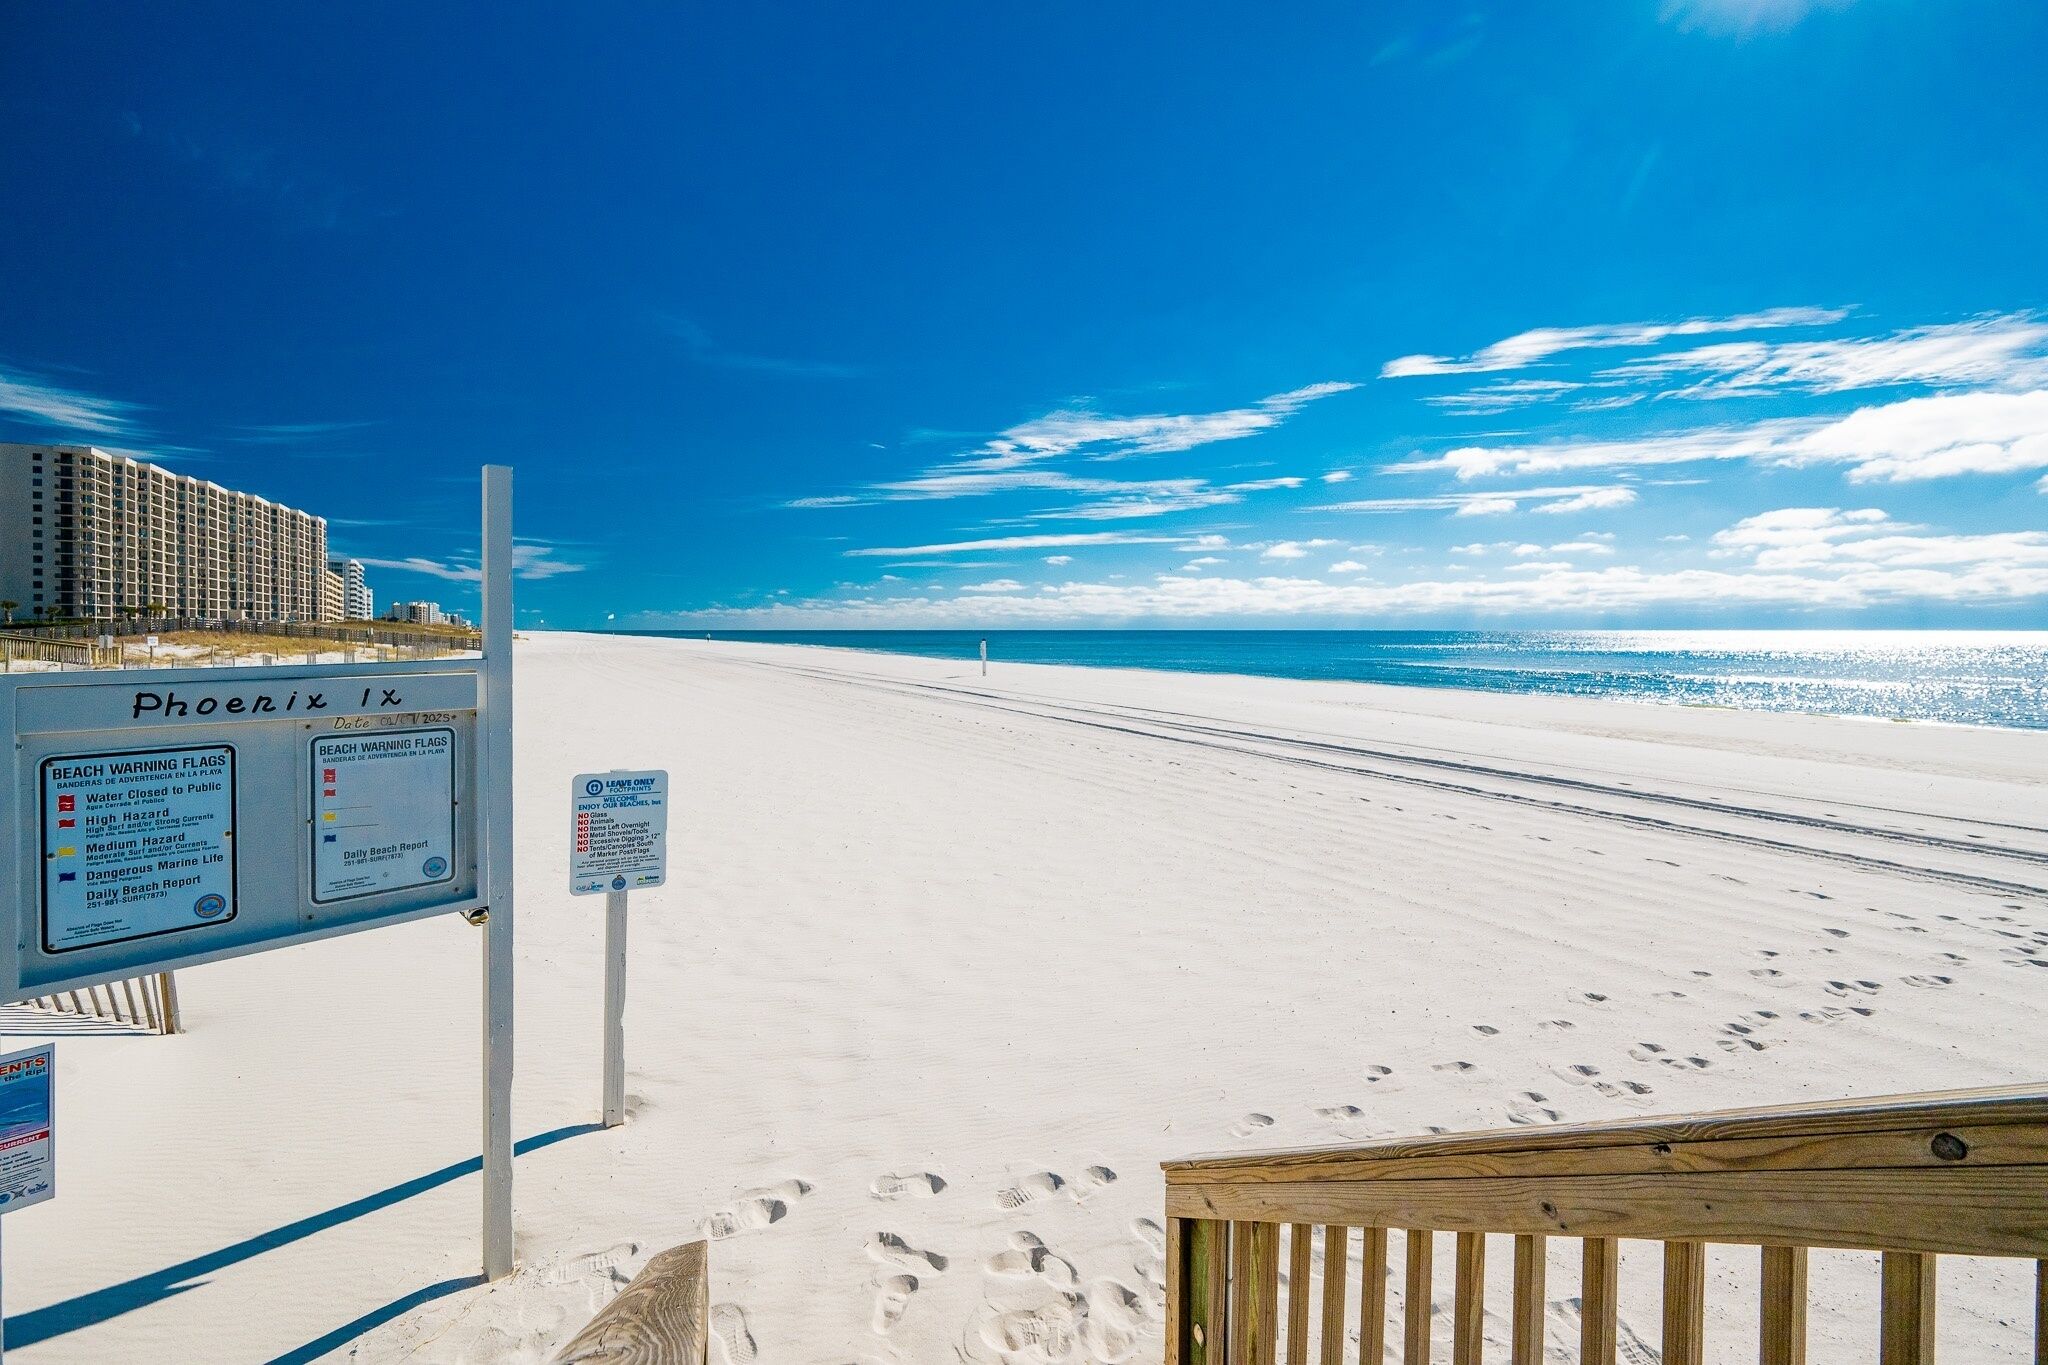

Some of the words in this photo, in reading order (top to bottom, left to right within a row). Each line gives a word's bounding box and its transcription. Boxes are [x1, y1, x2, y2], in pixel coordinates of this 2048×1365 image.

[132, 691, 327, 719] Phoenix
[333, 716, 370, 730] Date
[319, 742, 358, 756] BEACH
[360, 738, 412, 752] WARNING
[414, 736, 448, 748] FLAGS
[322, 755, 356, 764] BANDERAS
[368, 751, 408, 760] ADVERTENCIA
[52, 765, 104, 780] BEACH
[109, 758, 177, 775] WARNING
[182, 755, 226, 769] FLAGS
[56, 779, 103, 790] BANDERAS
[118, 772, 173, 784] ADVERTENCIA
[200, 768, 223, 776] PLAYA
[606, 780, 632, 788] LEAVE
[634, 778, 656, 786] ONLY
[86, 792, 124, 804] Water
[127, 786, 168, 799] Closed
[172, 785, 184, 795] to
[187, 782, 222, 794] Public
[610, 786, 652, 794] FOOTPRINTS
[105, 800, 131, 808] Cerrada
[578, 803, 600, 811] ENJOY
[604, 795, 638, 803] WELCOME!
[86, 814, 116, 826] High
[122, 808, 170, 822] Hazard
[86, 826, 104, 834] High
[107, 824, 124, 832] Surf
[127, 820, 152, 830] and/or
[154, 817, 180, 826] Strong
[182, 813, 214, 822] Currents
[621, 821, 650, 830] Overnight
[608, 828, 649, 837] Shovels/Tools
[621, 834, 644, 843] Digging
[86, 840, 136, 854] Medium
[142, 832, 186, 846] Hazard
[86, 852, 126, 861] Moderate
[128, 848, 145, 856] Surf
[147, 844, 172, 854] and/or
[175, 840, 208, 850] Currents
[344, 849, 368, 861] Daily
[370, 844, 397, 856] Beach
[400, 840, 429, 852] Report
[590, 843, 636, 852] Tents/Canopies
[619, 847, 650, 856] Post/Flags
[86, 864, 154, 882] Dangerous
[158, 857, 198, 871] Marine
[202, 853, 224, 865] Life
[86, 888, 119, 902] Daily
[122, 882, 159, 896] Beach
[162, 874, 201, 890] Report
[86, 890, 168, 910] 251-981-SURF(7873)
[4, 1074, 22, 1082] the
[25, 1066, 46, 1076] Rip!
